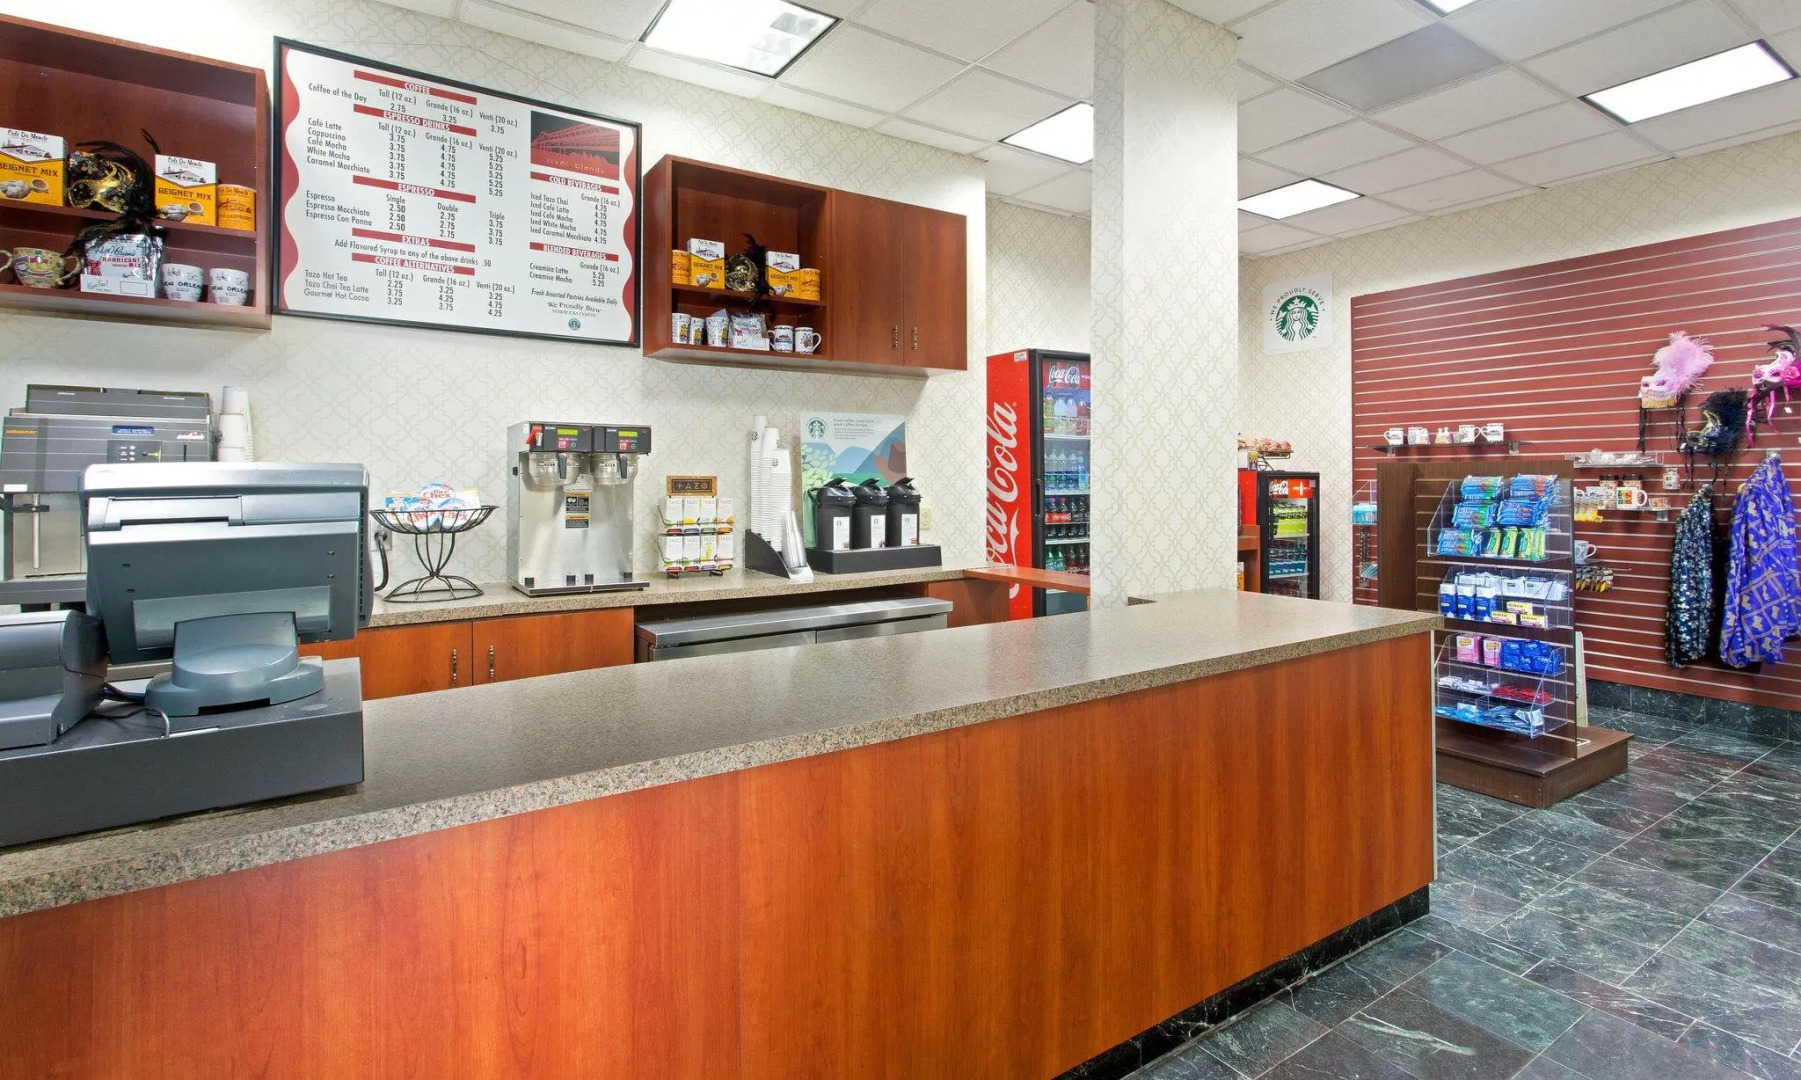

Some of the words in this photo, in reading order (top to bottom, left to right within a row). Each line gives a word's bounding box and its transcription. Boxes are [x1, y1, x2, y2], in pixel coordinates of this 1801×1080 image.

[308, 82, 331, 94] Coffee
[332, 87, 340, 96] of
[341, 89, 352, 99] the
[353, 91, 367, 104] Day
[403, 81, 431, 95] COFFEE
[378, 88, 390, 98] Tall
[391, 90, 403, 101] (12
[403, 95, 416, 105] oz.)
[389, 102, 406, 113] 2.75
[382, 110, 421, 125] ESPRESSO
[422, 118, 450, 132] DRINKS
[441, 113, 457, 124] 3.25
[324, 120, 342, 131] Latte
[377, 121, 389, 131] Tall
[390, 124, 402, 135] (12
[403, 128, 416, 138] oz.)
[489, 124, 504, 134] 3.75
[307, 126, 346, 141] Cappuccino
[388, 132, 405, 144] 3.75
[324, 139, 347, 151] Mocha
[388, 141, 405, 152] 3.75
[440, 143, 456, 154] 4.75
[306, 145, 326, 156] White
[328, 149, 350, 161] Mocha
[388, 151, 405, 162] 3.75
[440, 152, 456, 162] 4.75
[488, 152, 503, 163] 5.25
[306, 154, 335, 167] Caramel
[336, 160, 370, 174] Macchiato
[388, 160, 405, 171] 3.75
[439, 161, 455, 171] 4.75
[488, 161, 503, 171] 5.25
[41, 168, 58, 177] MIX
[388, 170, 405, 180] 3.75
[439, 169, 455, 180] 4.75
[488, 169, 503, 180] 5.25
[439, 178, 455, 188] 4.75
[488, 178, 503, 188] 5.25
[548, 175, 566, 186] COLD
[567, 178, 602, 192] BEVERAGES
[158, 187, 194, 199] BEIGNET
[196, 192, 212, 201] MIX
[397, 182, 436, 197] ESPRESSO
[488, 187, 503, 197] 5.25
[305, 189, 335, 202] Espresso
[385, 193, 406, 204] Single
[530, 191, 542, 201] Iced
[542, 194, 555, 203] Tazo
[556, 196, 568, 205] Chai
[305, 199, 334, 211] Espresso
[336, 204, 370, 216] Macchiato
[388, 202, 406, 213] 2.50
[437, 201, 458, 212] Double
[530, 200, 542, 209] Iced
[556, 204, 569, 214] Latte
[305, 208, 334, 221] Espresso
[336, 213, 349, 223] Con
[351, 215, 372, 226] Panna
[388, 212, 405, 222] 2.50
[439, 211, 455, 221] 2.75
[488, 210, 505, 221] Triple
[530, 208, 542, 217] Iced
[556, 213, 573, 223] Mocha
[388, 221, 405, 231] 2.50
[439, 220, 455, 230] 2.75
[488, 219, 503, 229] 3.75
[530, 217, 541, 226] Iced
[542, 219, 558, 228] White
[558, 221, 576, 231] Mocha
[439, 229, 455, 239] 2.75
[488, 227, 503, 237] 3.75
[530, 225, 541, 234] Iced
[542, 227, 565, 238] Caramel
[565, 231, 591, 242] Macchiato
[401, 234, 430, 247] EXTRAS
[488, 236, 502, 246] 3.75
[334, 238, 348, 248] Add
[349, 240, 378, 252] Flavored
[379, 244, 398, 256] Syrup
[399, 248, 406, 256] to
[407, 250, 420, 258] any
[420, 250, 428, 258] of
[428, 251, 439, 260] the
[440, 253, 458, 262] above
[459, 255, 478, 265] drinks
[542, 243, 571, 256] BLENDED
[571, 248, 607, 261] BEVERAGES
[374, 255, 402, 267] COFFEE
[403, 259, 454, 273] ALTERNATIVES
[304, 269, 320, 278] Tazo
[322, 271, 334, 280] Hot
[335, 272, 347, 282] Tea
[374, 267, 387, 277] Tall
[388, 269, 400, 279] (12
[401, 272, 414, 282] oz.)
[554, 266, 568, 274] Latte
[387, 279, 403, 289] 2.25
[554, 274, 572, 283] Mocha
[304, 278, 320, 288] Tazo
[321, 280, 337, 290] Chai
[338, 282, 351, 291] Tea
[352, 284, 369, 293] Latte
[438, 285, 454, 294] 3.25
[303, 287, 333, 298] Gourmet
[334, 290, 347, 299] Hot
[348, 292, 369, 302] Cocoa
[387, 287, 403, 297] 3.75
[488, 291, 502, 300] 3.25
[1277, 287, 1307, 303] PROUDLY
[1308, 288, 1325, 305] SERVE
[386, 296, 402, 306] 3.25
[438, 293, 454, 303] 4.25
[438, 302, 453, 311] 3.75
[488, 300, 502, 309] 4.75
[558, 301, 584, 311] Proudly
[487, 308, 502, 317] 4.25
